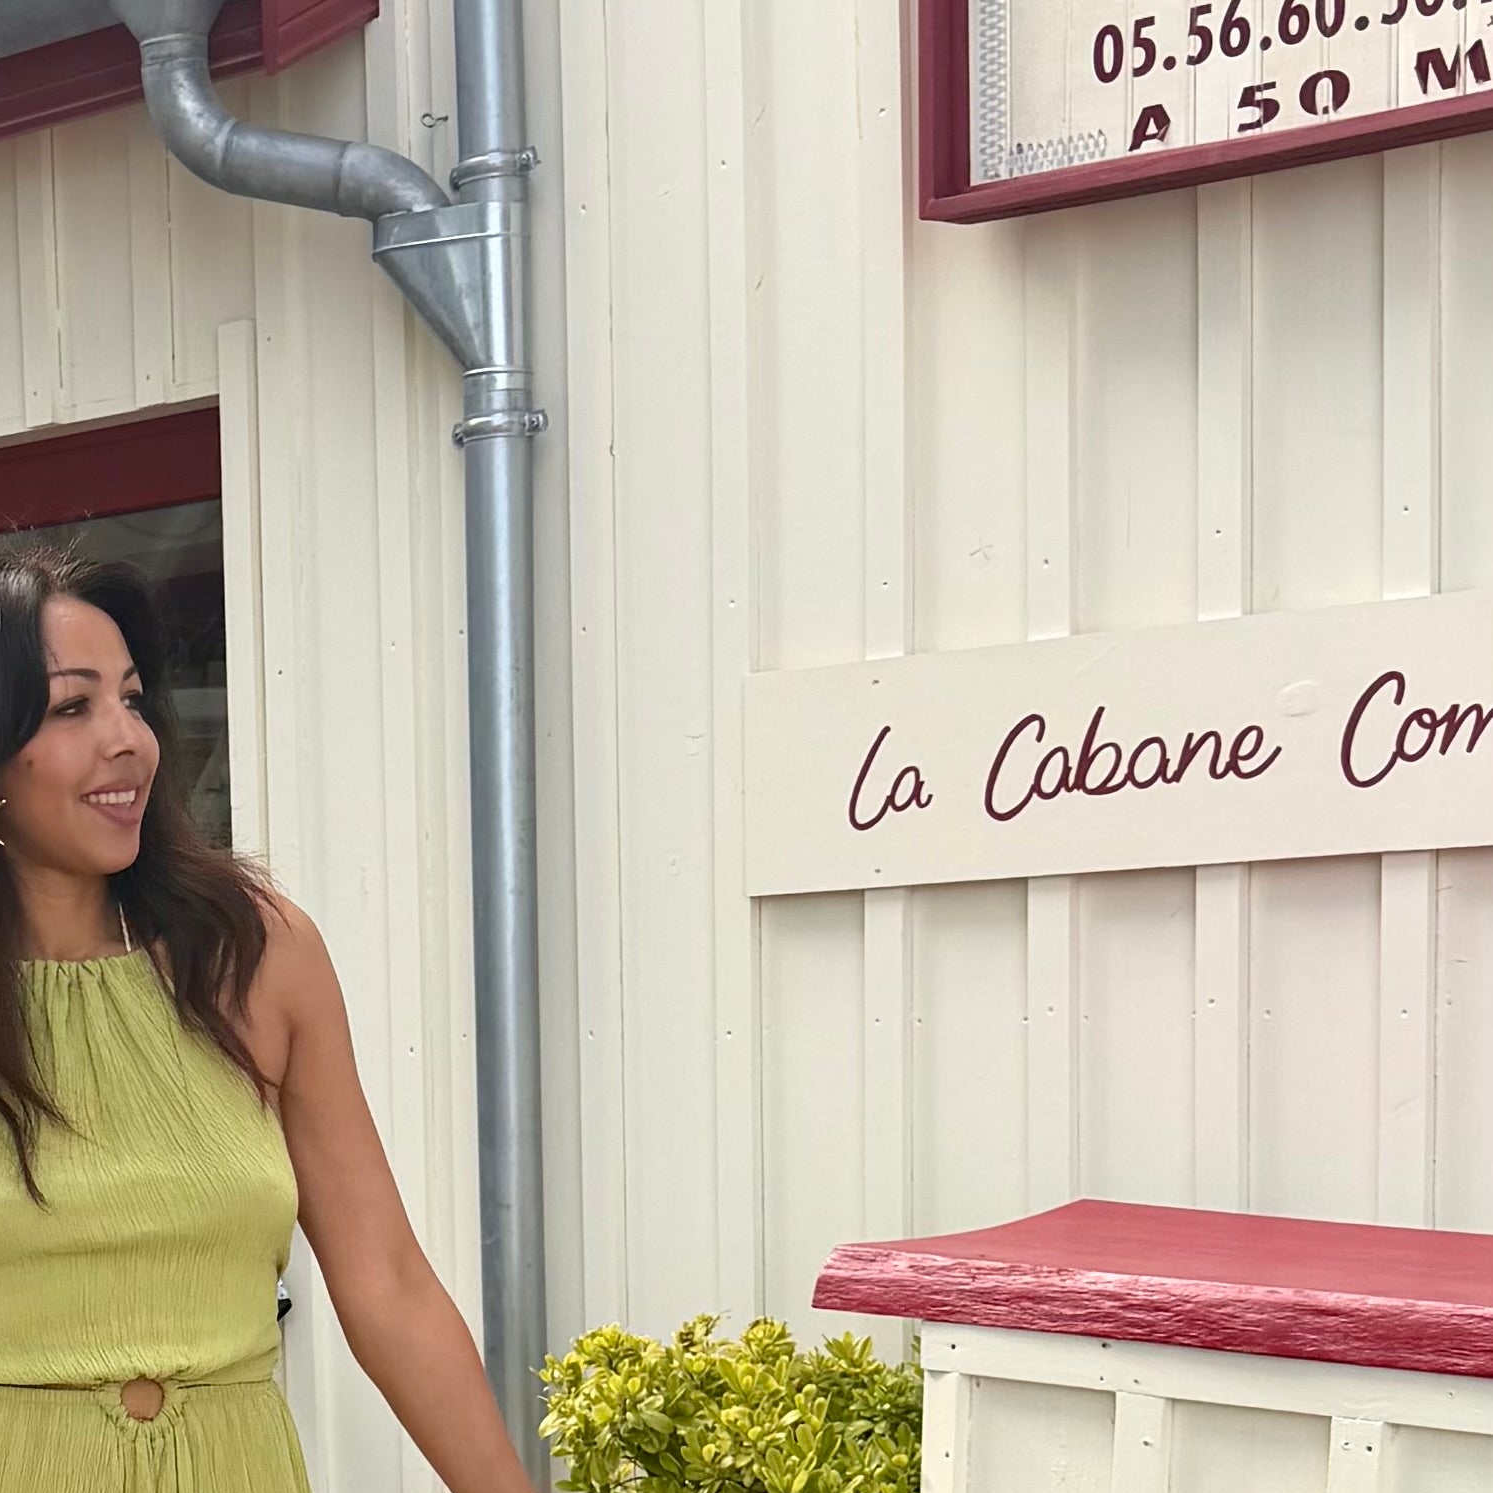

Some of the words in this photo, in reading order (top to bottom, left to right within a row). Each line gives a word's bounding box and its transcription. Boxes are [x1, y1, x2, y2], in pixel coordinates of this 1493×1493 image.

[1128, 103, 1171, 151] A
[1237, 69, 1350, 133] 50
[848, 725, 933, 831] La
[984, 705, 1282, 822] Cabane
